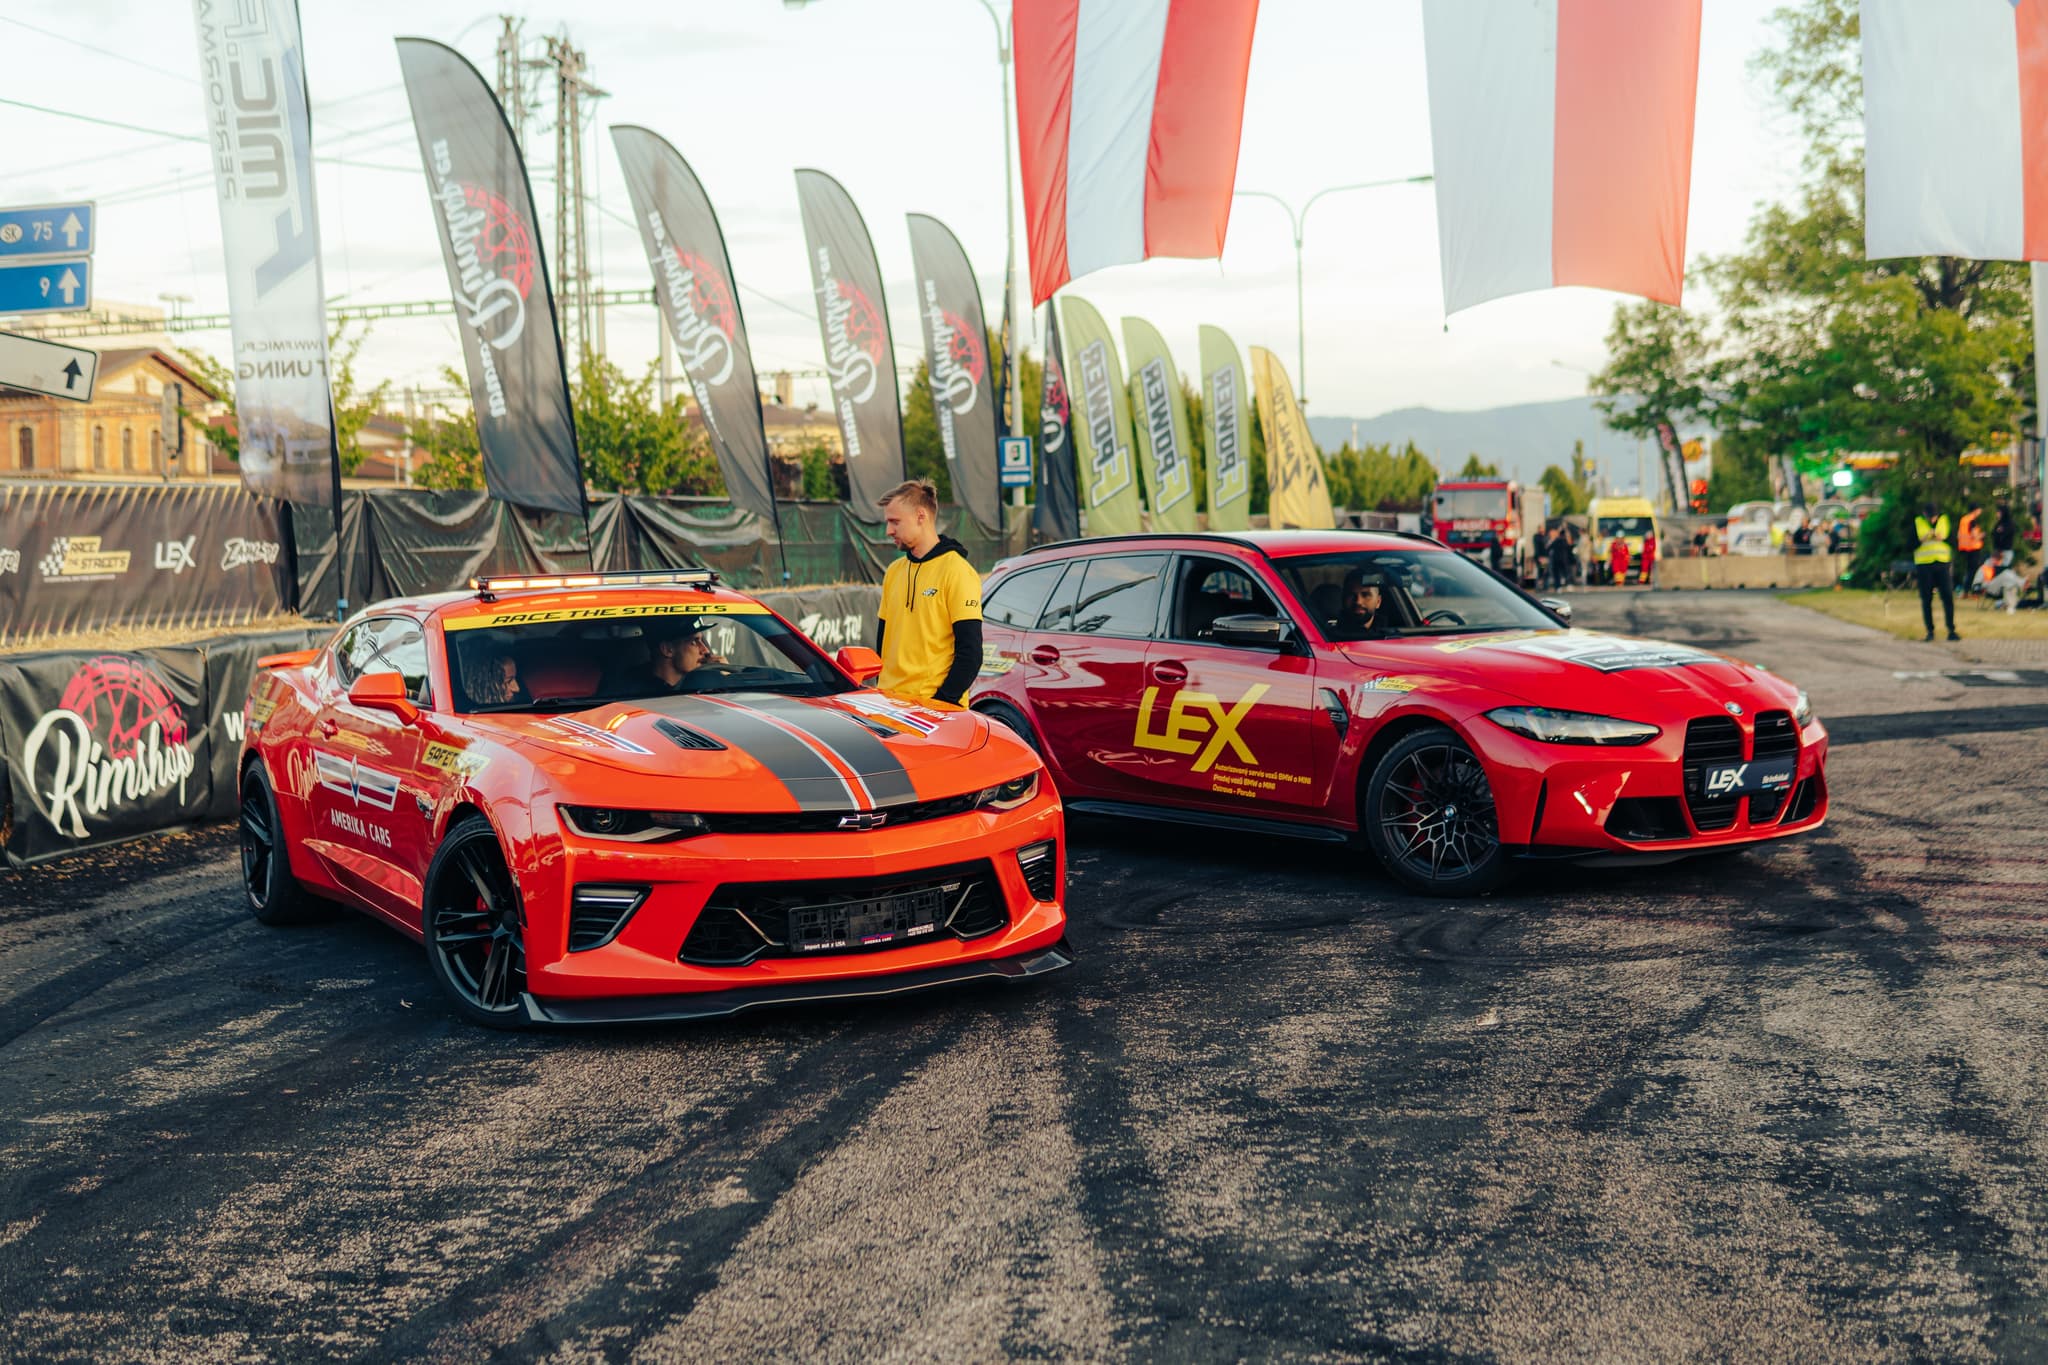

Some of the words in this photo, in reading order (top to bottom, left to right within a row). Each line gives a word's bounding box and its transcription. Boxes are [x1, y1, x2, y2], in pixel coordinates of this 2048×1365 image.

[32, 221, 53, 241] 75
[39, 276, 50, 298] 9
[155, 535, 196, 575] LEX
[492, 612, 562, 625] RACE
[568, 608, 617, 618] THE
[622, 604, 729, 615] STREETS
[844, 614, 863, 644] TO!
[1133, 683, 1272, 773] LEX
[24, 708, 195, 839] Rimshop
[1708, 763, 1749, 793] LEX
[331, 807, 367, 840] AMERIKA
[369, 823, 392, 849] CARS
